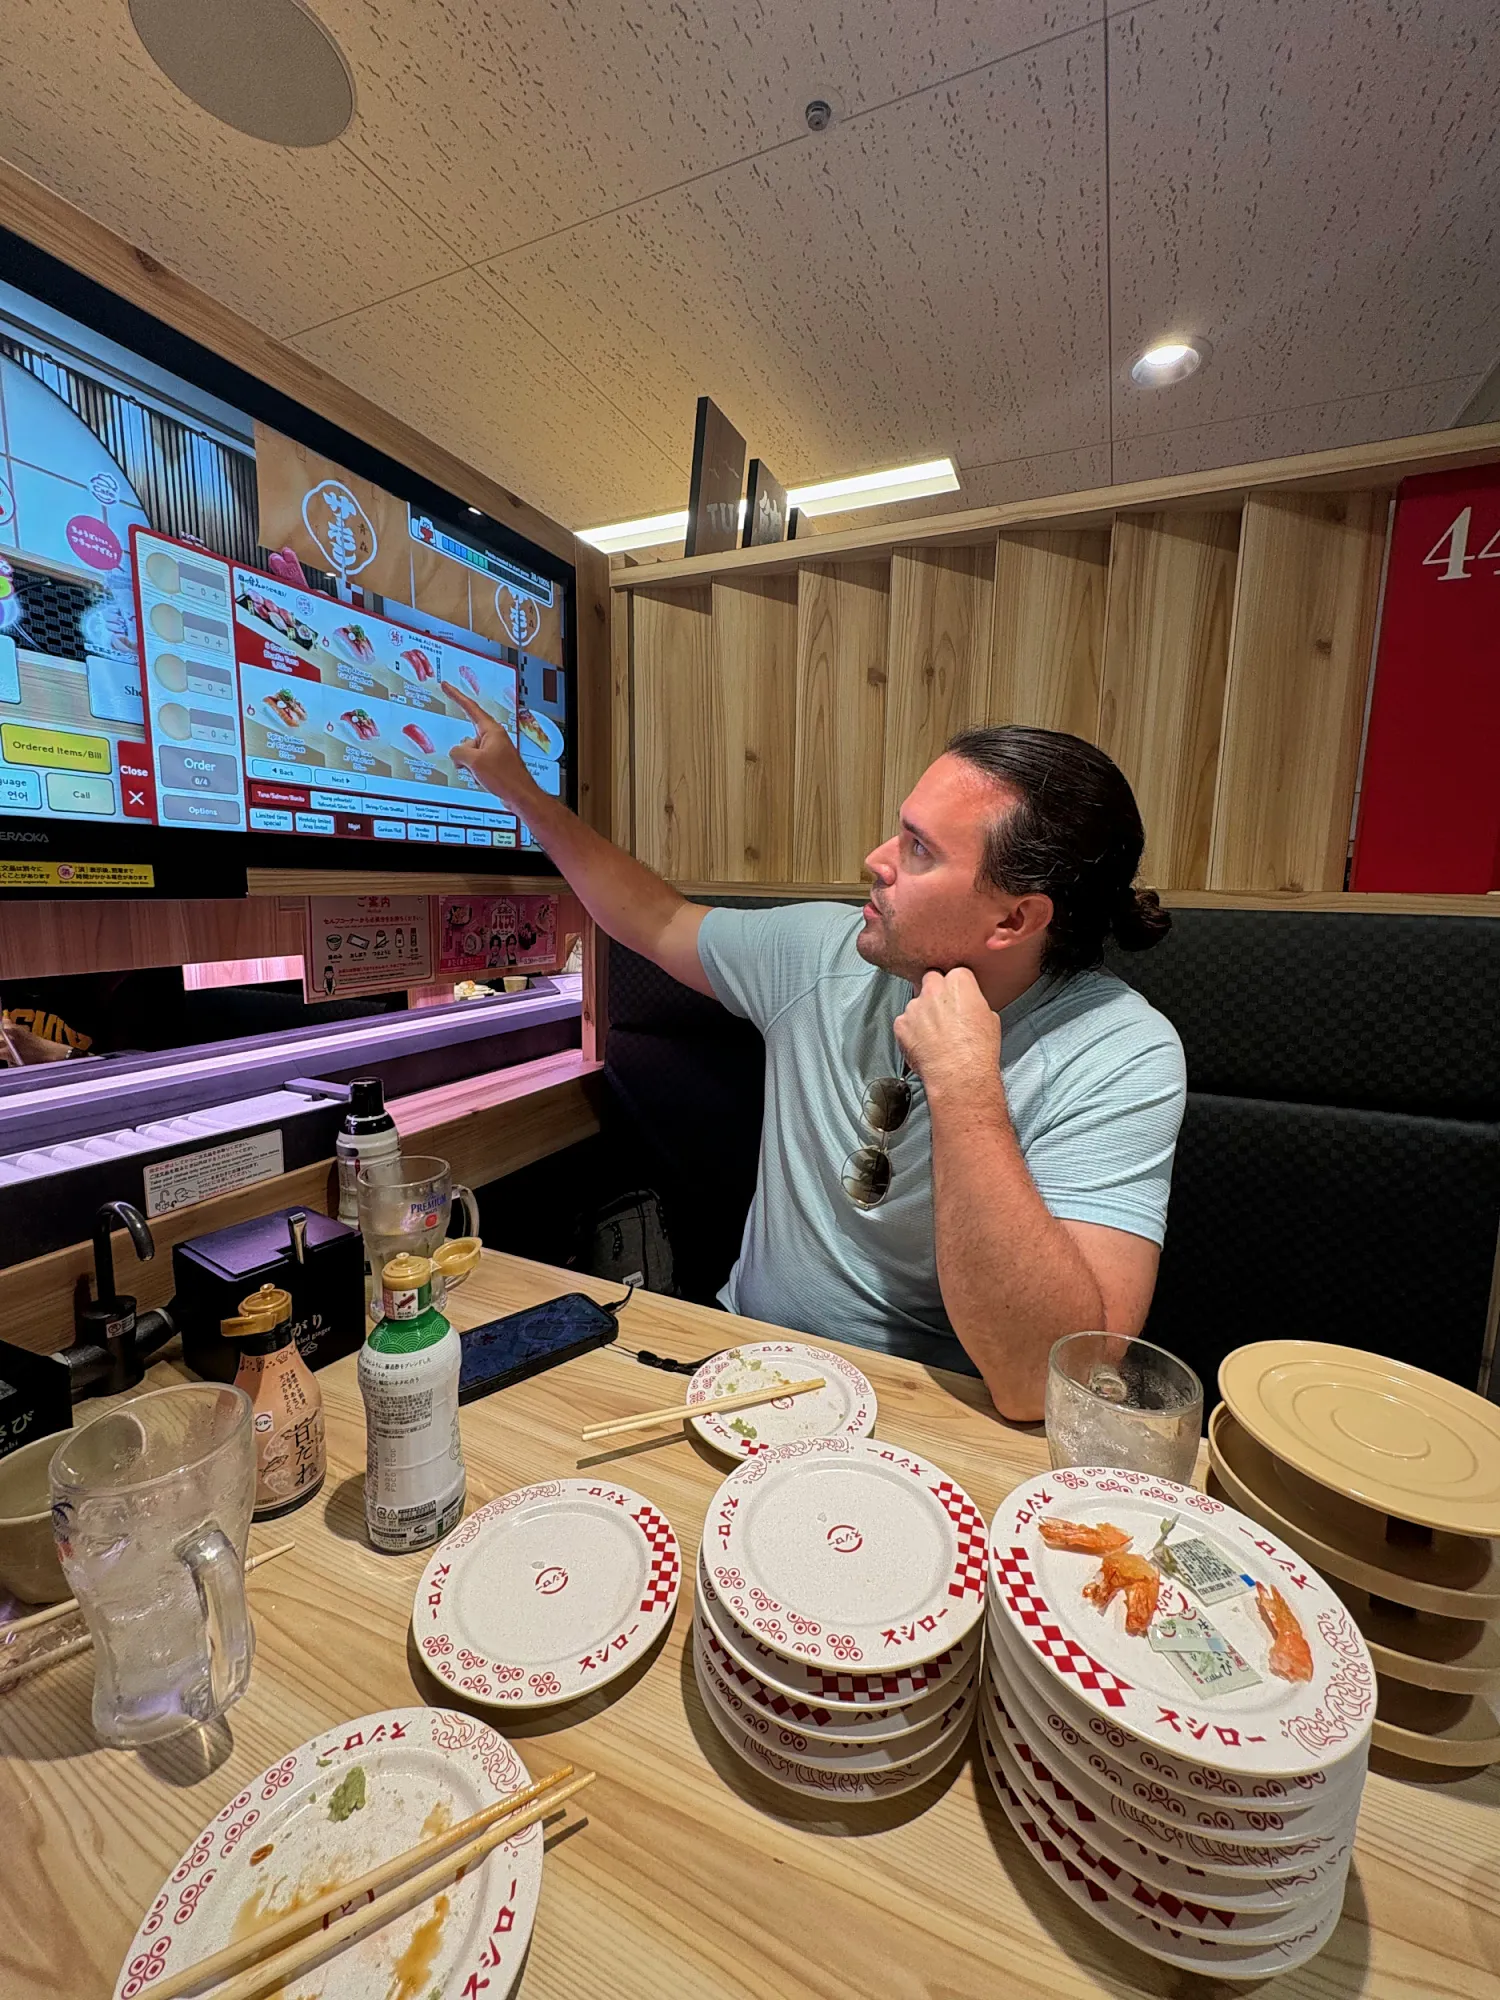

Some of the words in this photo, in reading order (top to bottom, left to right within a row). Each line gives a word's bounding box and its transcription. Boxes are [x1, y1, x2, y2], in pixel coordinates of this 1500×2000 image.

[12, 741, 54, 754] Ordered
[57, 747, 102, 760] Items/Bill
[120, 765, 148, 777] Close
[184, 757, 216, 773] Order
[280, 768, 294, 776] Back
[8, 790, 28, 802] 언어
[72, 790, 90, 799] Call
[188, 806, 218, 816] Options
[356, 896, 391, 908] ご案内
[410, 1193, 448, 1214] PREMIUM
[312, 1326, 332, 1341] ginger
[293, 1422, 318, 1488] 甘だれ
[866, 1448, 929, 1476] スシロー
[576, 1486, 632, 1506] スシロー
[717, 1494, 741, 1551] スシロー
[1014, 1488, 1054, 1534] スシロー
[1238, 1526, 1318, 1591] スシロー
[428, 1561, 452, 1620] スシロー
[880, 1608, 949, 1649] スシロー
[578, 1624, 640, 1676] スシロー
[322, 1721, 412, 1757] スシロー
[1155, 1706, 1267, 1748] スシロー
[460, 1878, 518, 2000] スシロー
